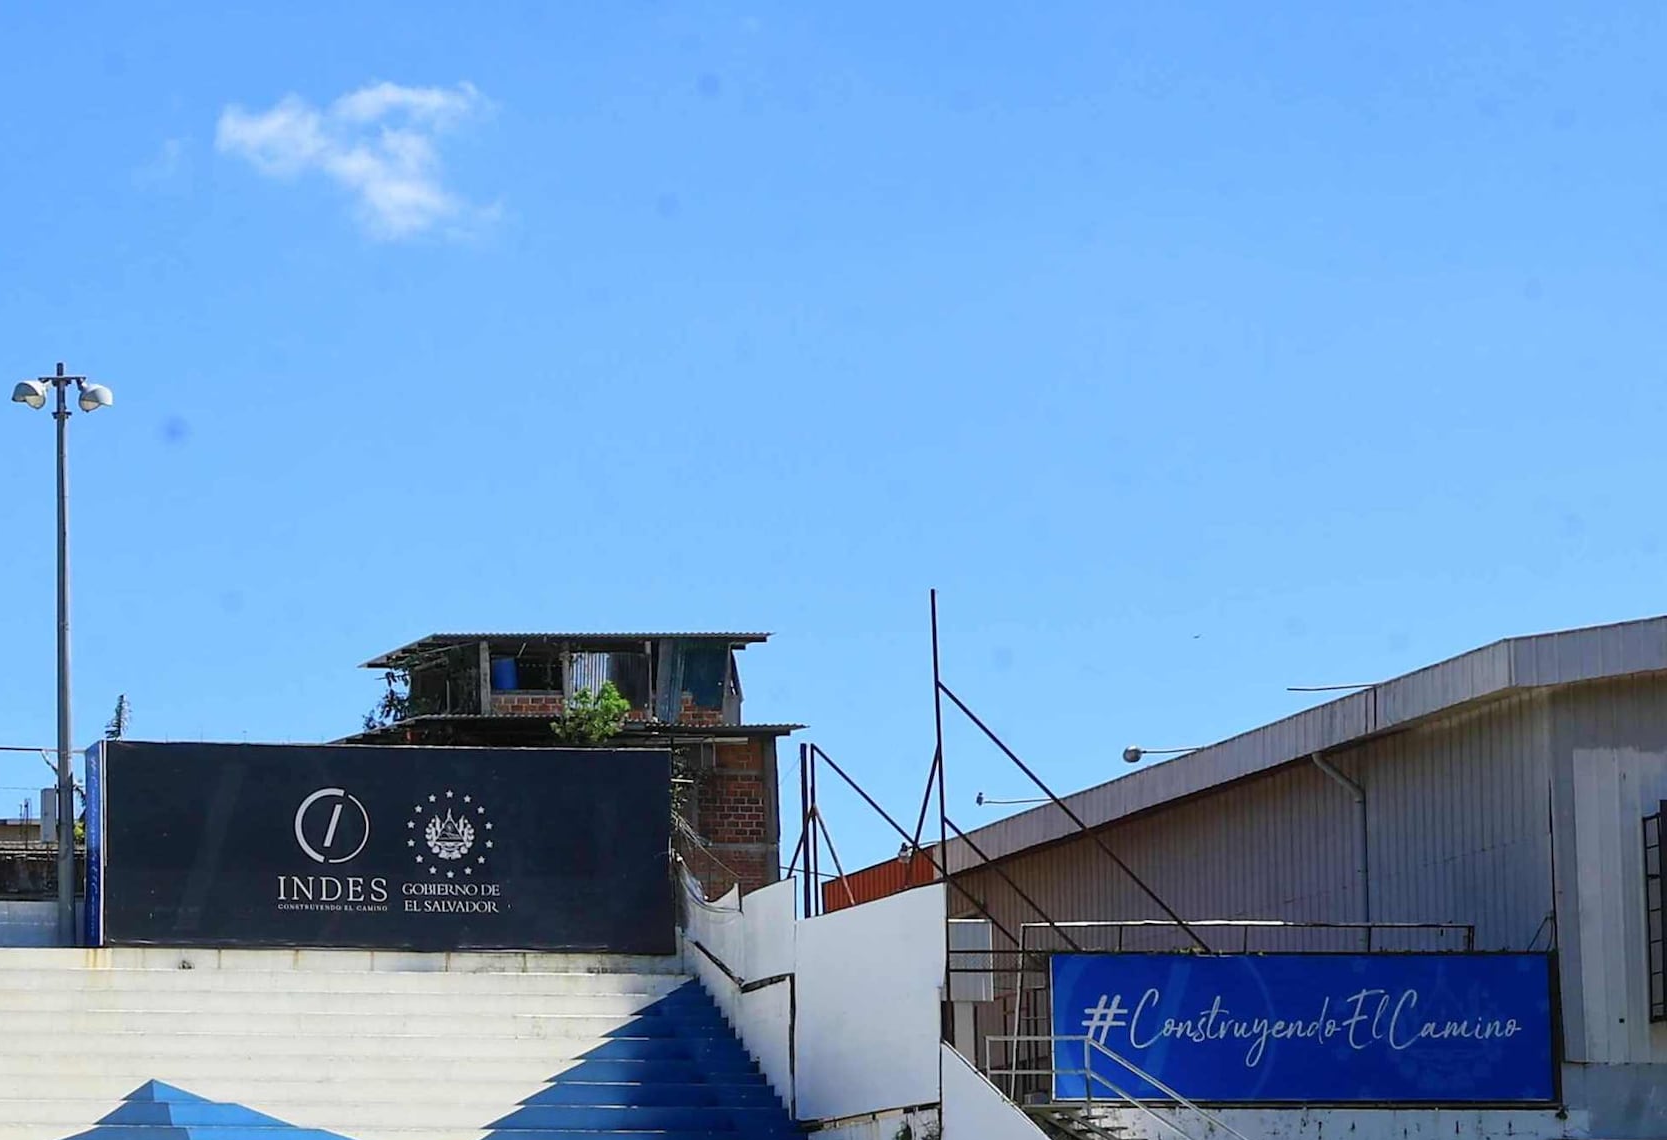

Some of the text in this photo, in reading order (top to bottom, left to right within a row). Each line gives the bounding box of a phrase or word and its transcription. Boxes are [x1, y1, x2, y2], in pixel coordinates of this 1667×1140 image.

[277, 876, 388, 902] INDES
[401, 882, 501, 898] GOBIERNO DE
[403, 899, 499, 914] EL SALVADOR
[1081, 987, 1522, 1068] #ConstruyendoElCamino
